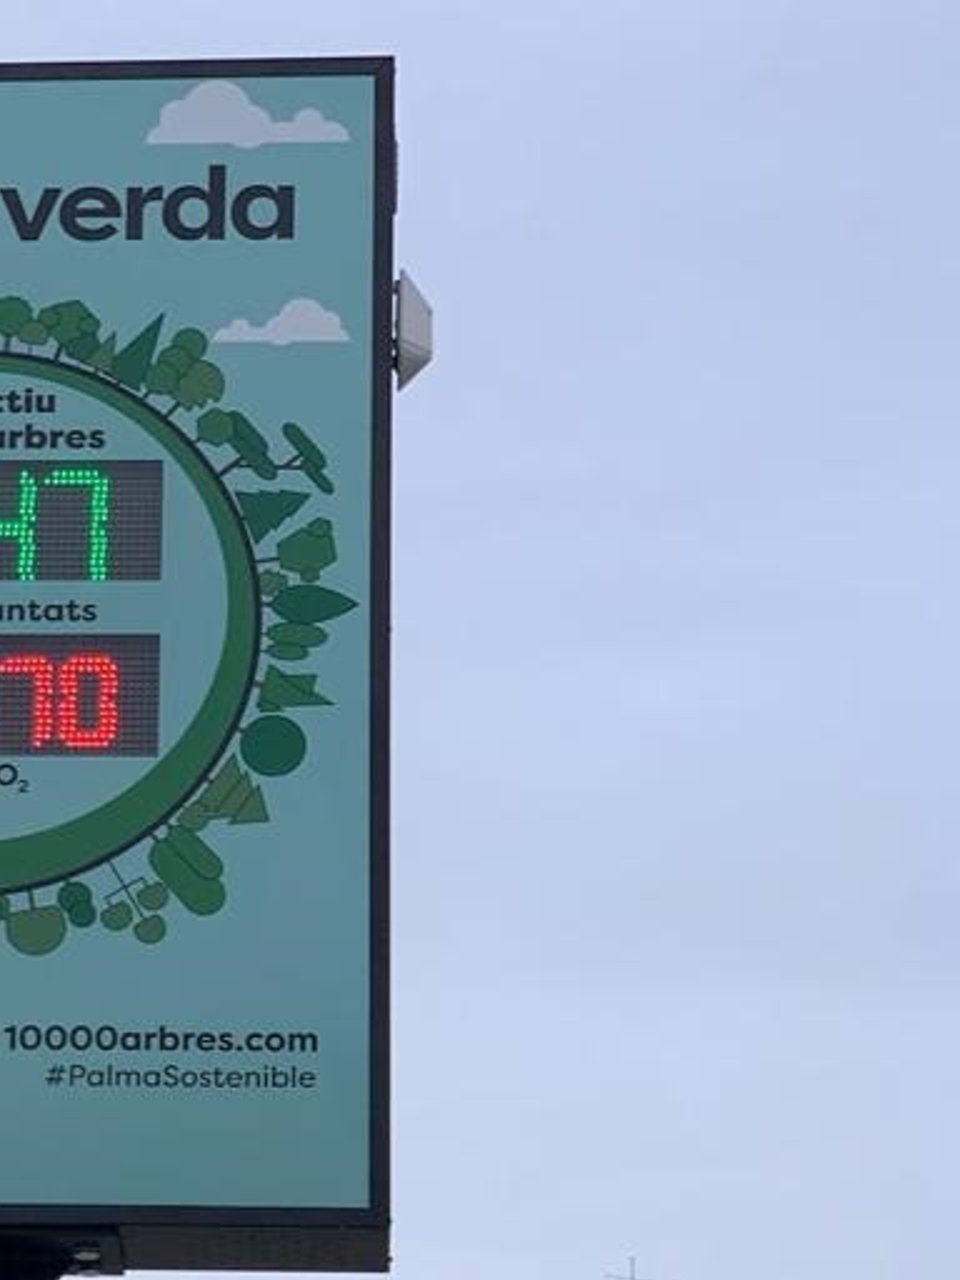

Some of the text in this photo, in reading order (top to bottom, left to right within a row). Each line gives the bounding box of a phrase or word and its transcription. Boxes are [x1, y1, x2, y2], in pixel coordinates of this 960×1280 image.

[0, 165, 296, 242] verda
[3, 1024, 319, 1052] 10000arbres.com
[45, 1063, 317, 1089] #PalmaSostenible
